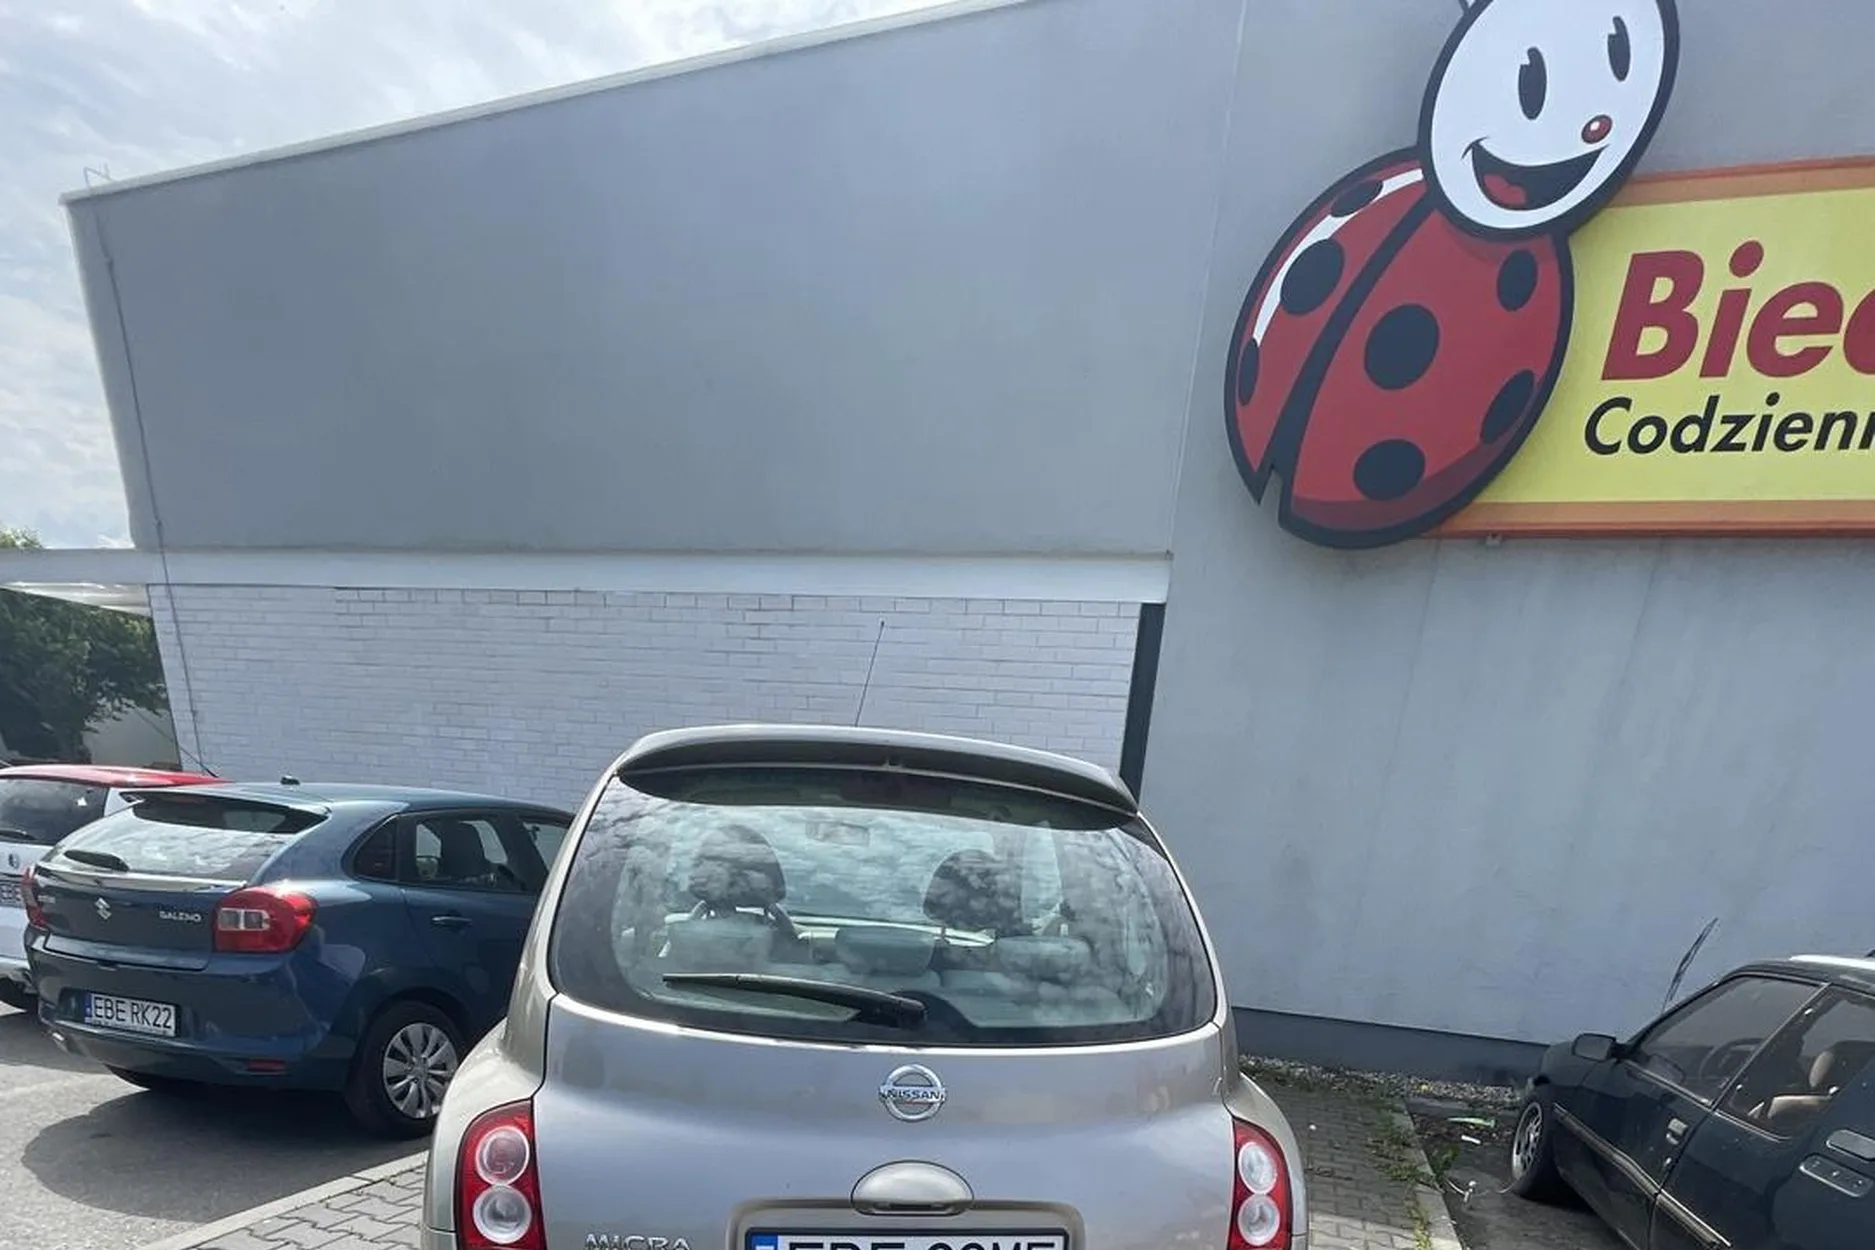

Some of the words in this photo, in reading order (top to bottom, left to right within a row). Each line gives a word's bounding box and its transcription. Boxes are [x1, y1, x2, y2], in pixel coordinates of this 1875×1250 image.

[94, 996, 126, 1022] EBE
[130, 1002, 172, 1029] RK22
[886, 1088, 942, 1100] NISSAN
